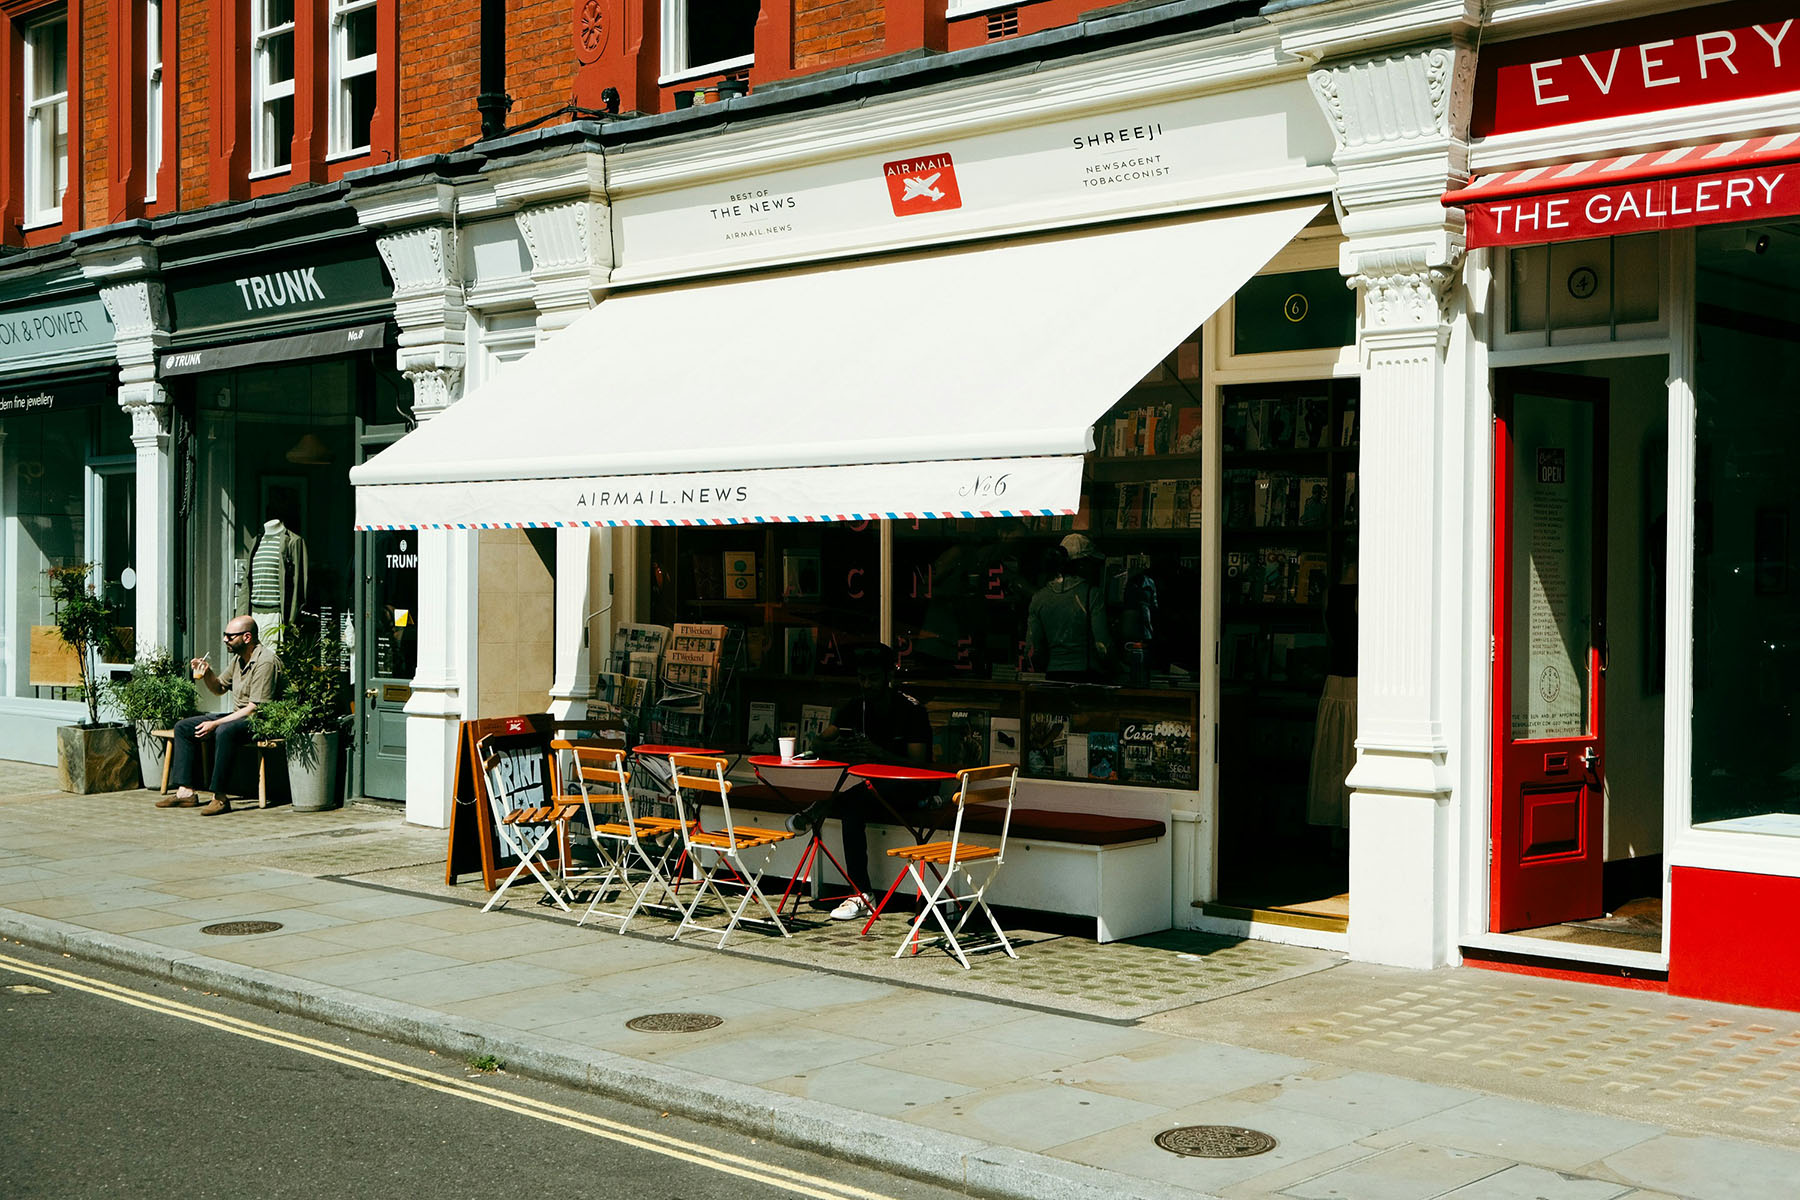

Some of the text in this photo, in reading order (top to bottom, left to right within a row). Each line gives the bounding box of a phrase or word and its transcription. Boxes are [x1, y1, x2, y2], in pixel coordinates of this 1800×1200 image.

[1530, 18, 1794, 106] EVERY
[1073, 123, 1162, 150] SHREEJI
[886, 157, 952, 176] AIR MAIL
[1086, 155, 1161, 174] NEWSAGENT
[1082, 167, 1171, 188] TOBACCONIST
[730, 189, 768, 202] BEST OF
[1490, 173, 1785, 233] THE GALLERY
[710, 197, 796, 219] THE NEWS
[725, 224, 793, 240] AIRMAIL.NEWS
[235, 267, 325, 310] TRUNK
[0, 311, 89, 344] OX & POWER
[347, 329, 365, 342] No.8
[174, 353, 202, 368] TRUNK
[14, 395, 26, 408] fine
[26, 392, 55, 411] jewellery
[1542, 466, 1562, 481] OPEN
[577, 487, 749, 507] AIRMAIL.NEWS
[690, 626, 713, 636] Weekend
[681, 653, 704, 662] Weekend
[1123, 724, 1154, 741] Casa
